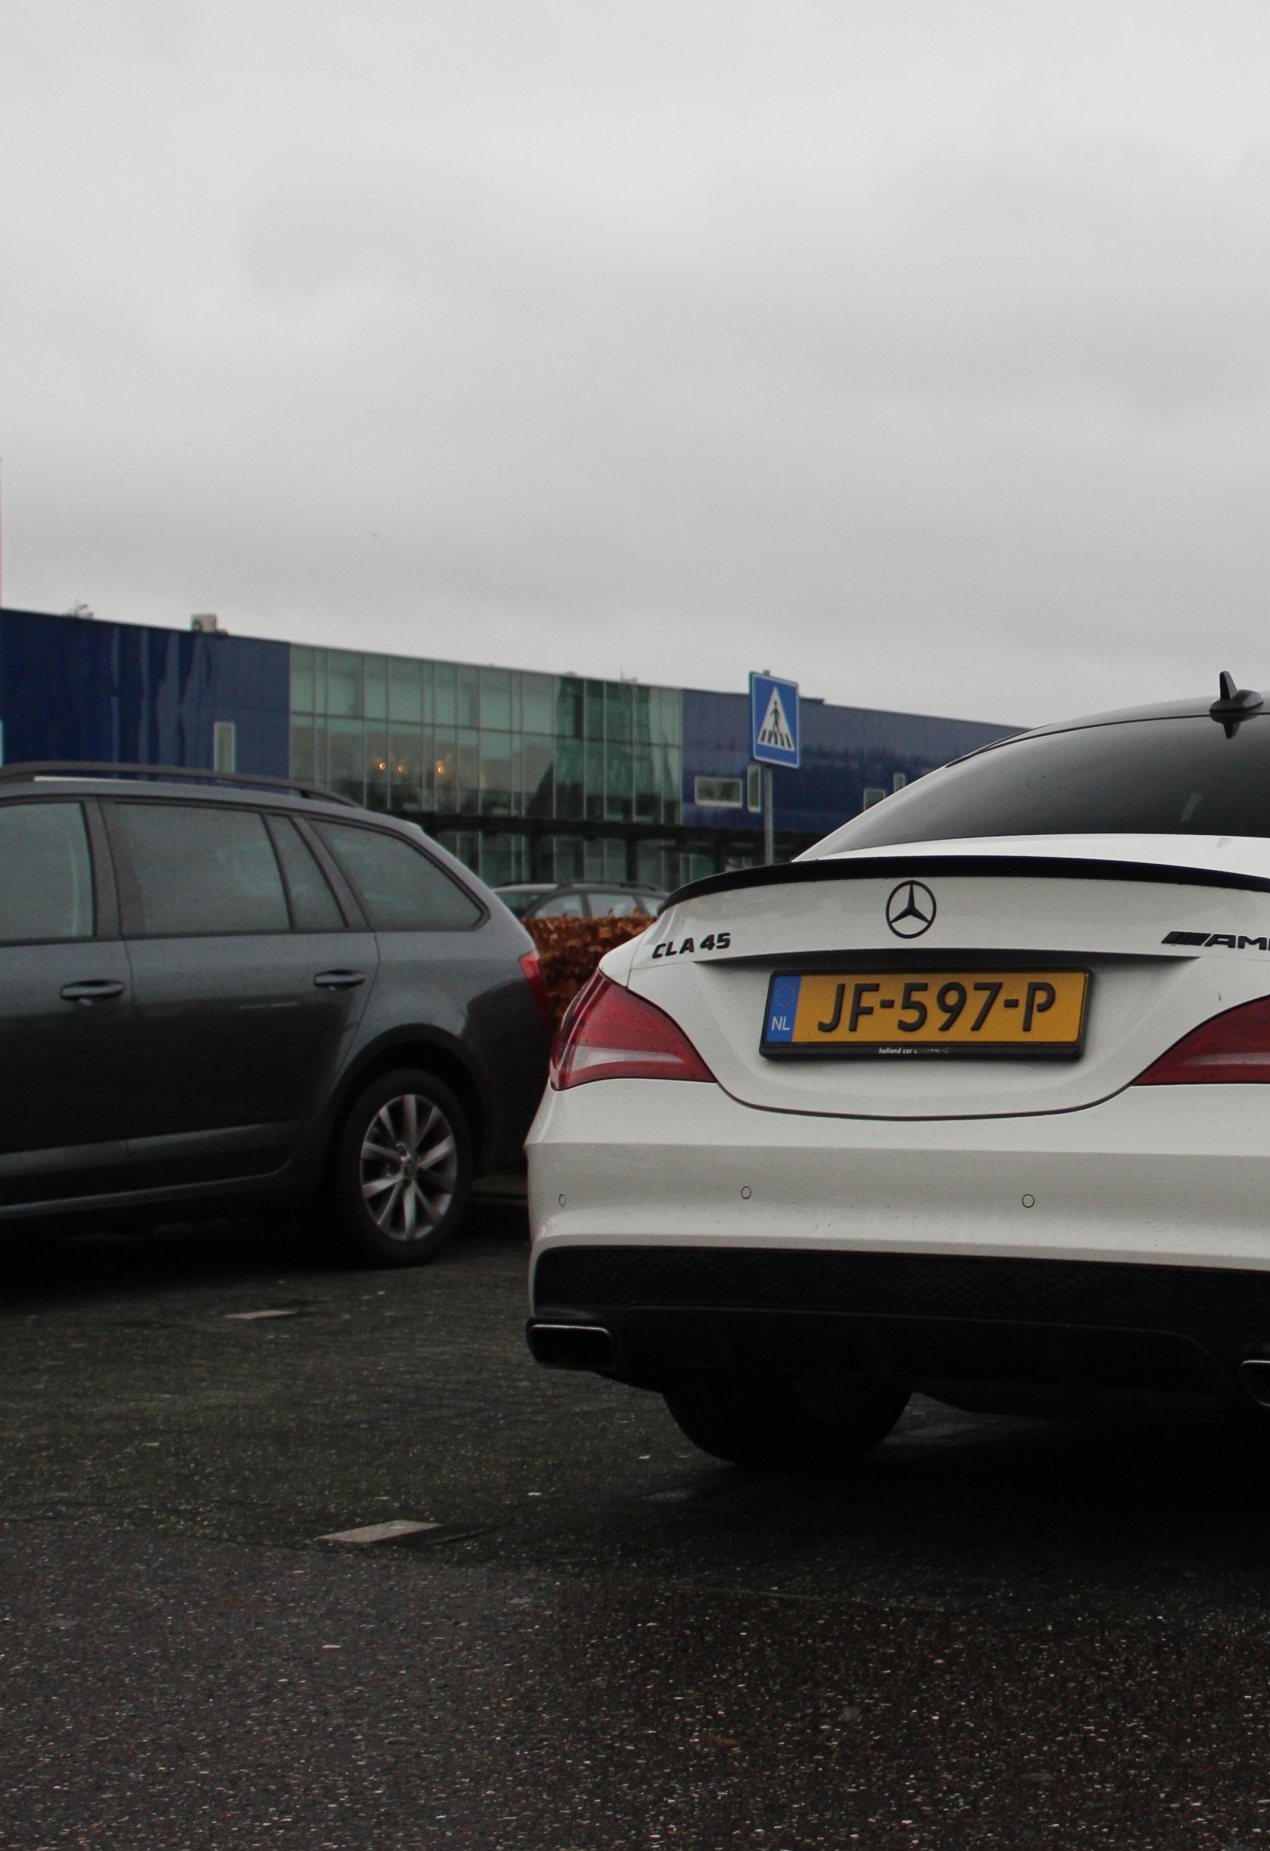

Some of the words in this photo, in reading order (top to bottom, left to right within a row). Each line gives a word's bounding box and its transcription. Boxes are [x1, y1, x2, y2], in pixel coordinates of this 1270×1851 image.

[652, 937, 695, 959] CLA
[700, 932, 731, 951] 45
[817, 981, 1057, 1033] JF-597-P
[771, 1016, 791, 1032] NL
[878, 1046, 902, 1054] holland
